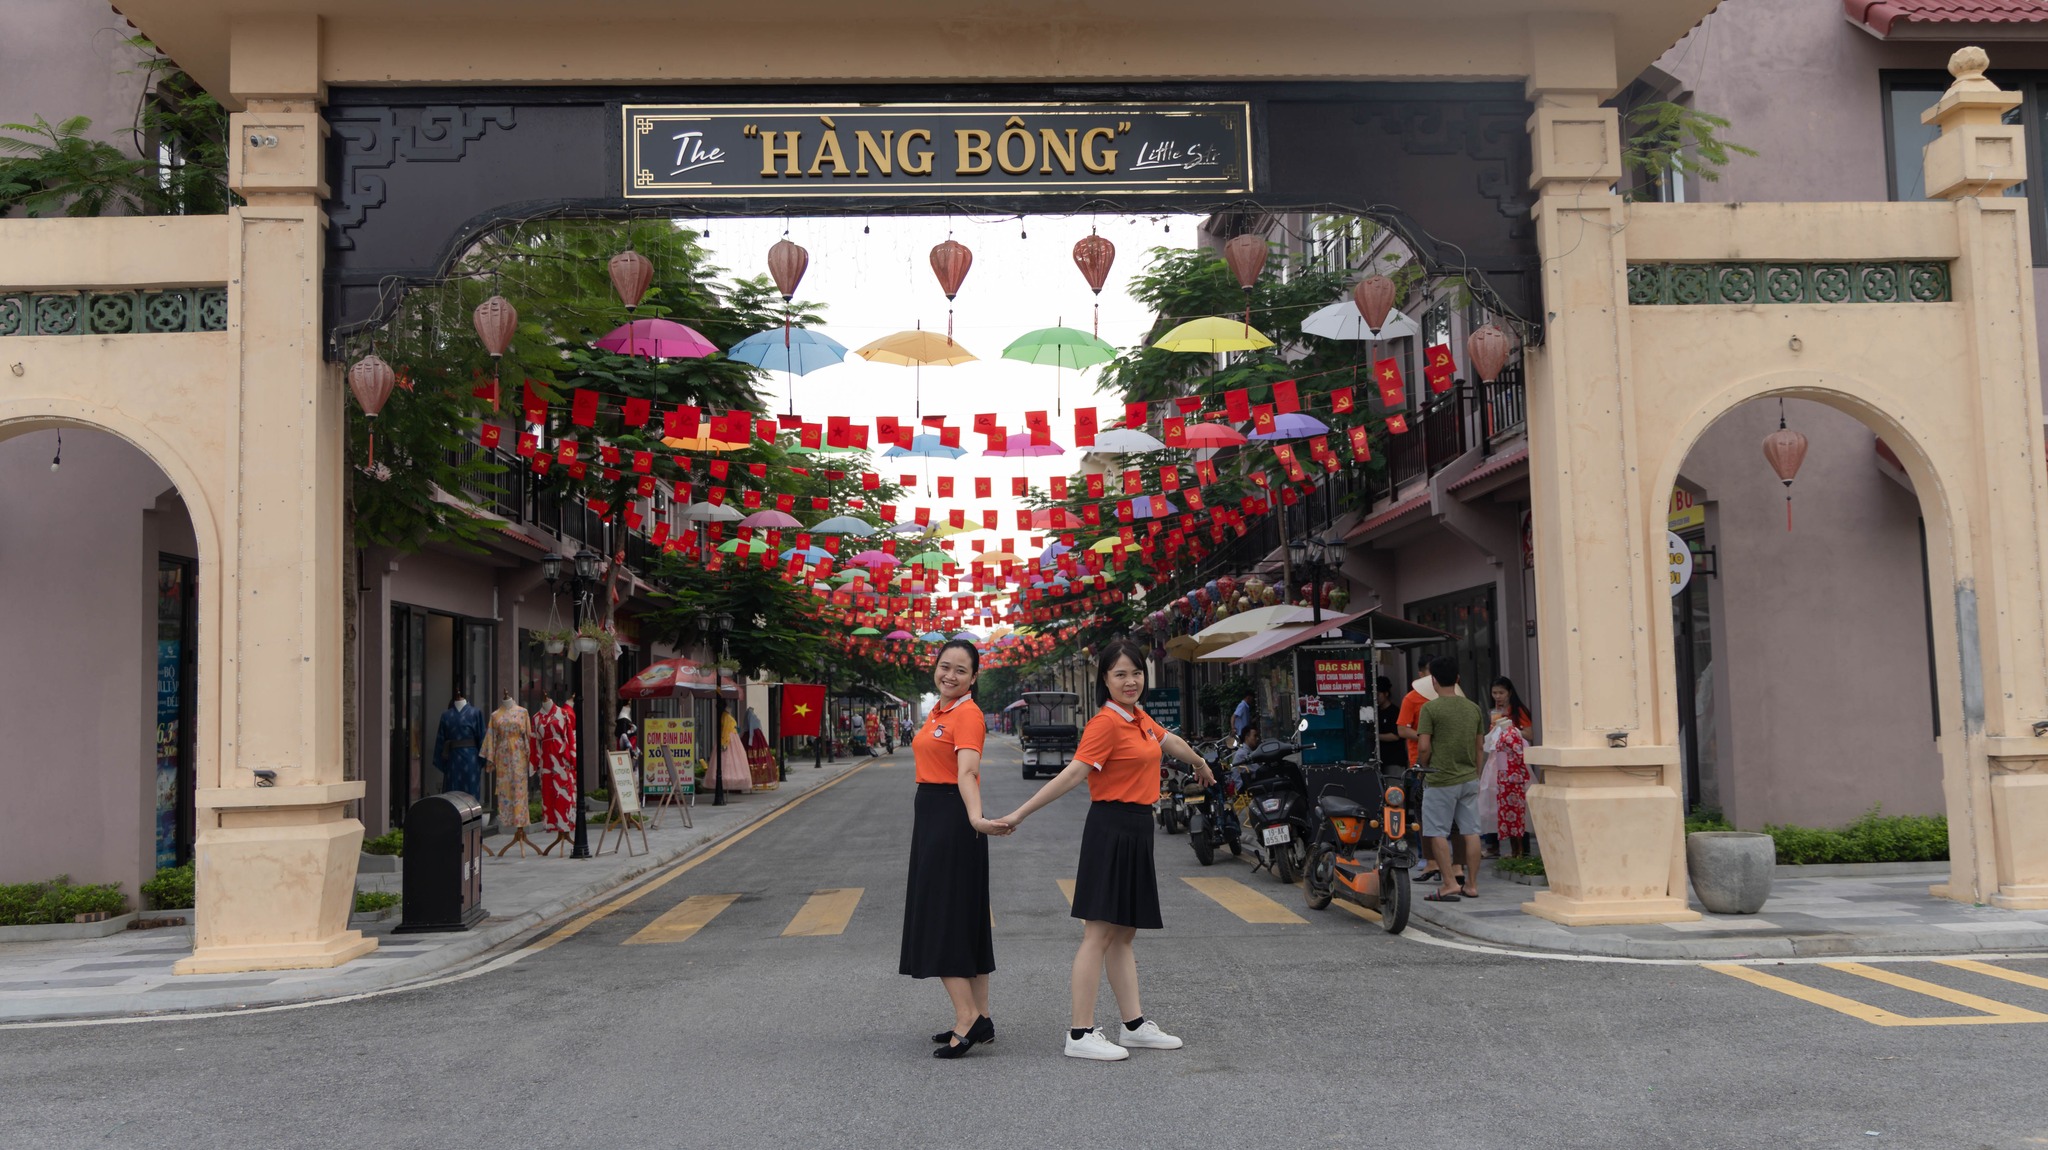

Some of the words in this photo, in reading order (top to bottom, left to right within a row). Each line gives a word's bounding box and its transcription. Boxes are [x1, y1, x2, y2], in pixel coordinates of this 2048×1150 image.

[672, 131, 725, 168] The
[1135, 140, 1182, 167] Little
[1318, 662, 1338, 673] ĐẶC
[1340, 661, 1361, 671] SẢN
[647, 731, 661, 745] CƠM
[663, 730, 678, 745] BÌNH
[679, 729, 692, 745] DÂN
[648, 746, 664, 758] XÔ
